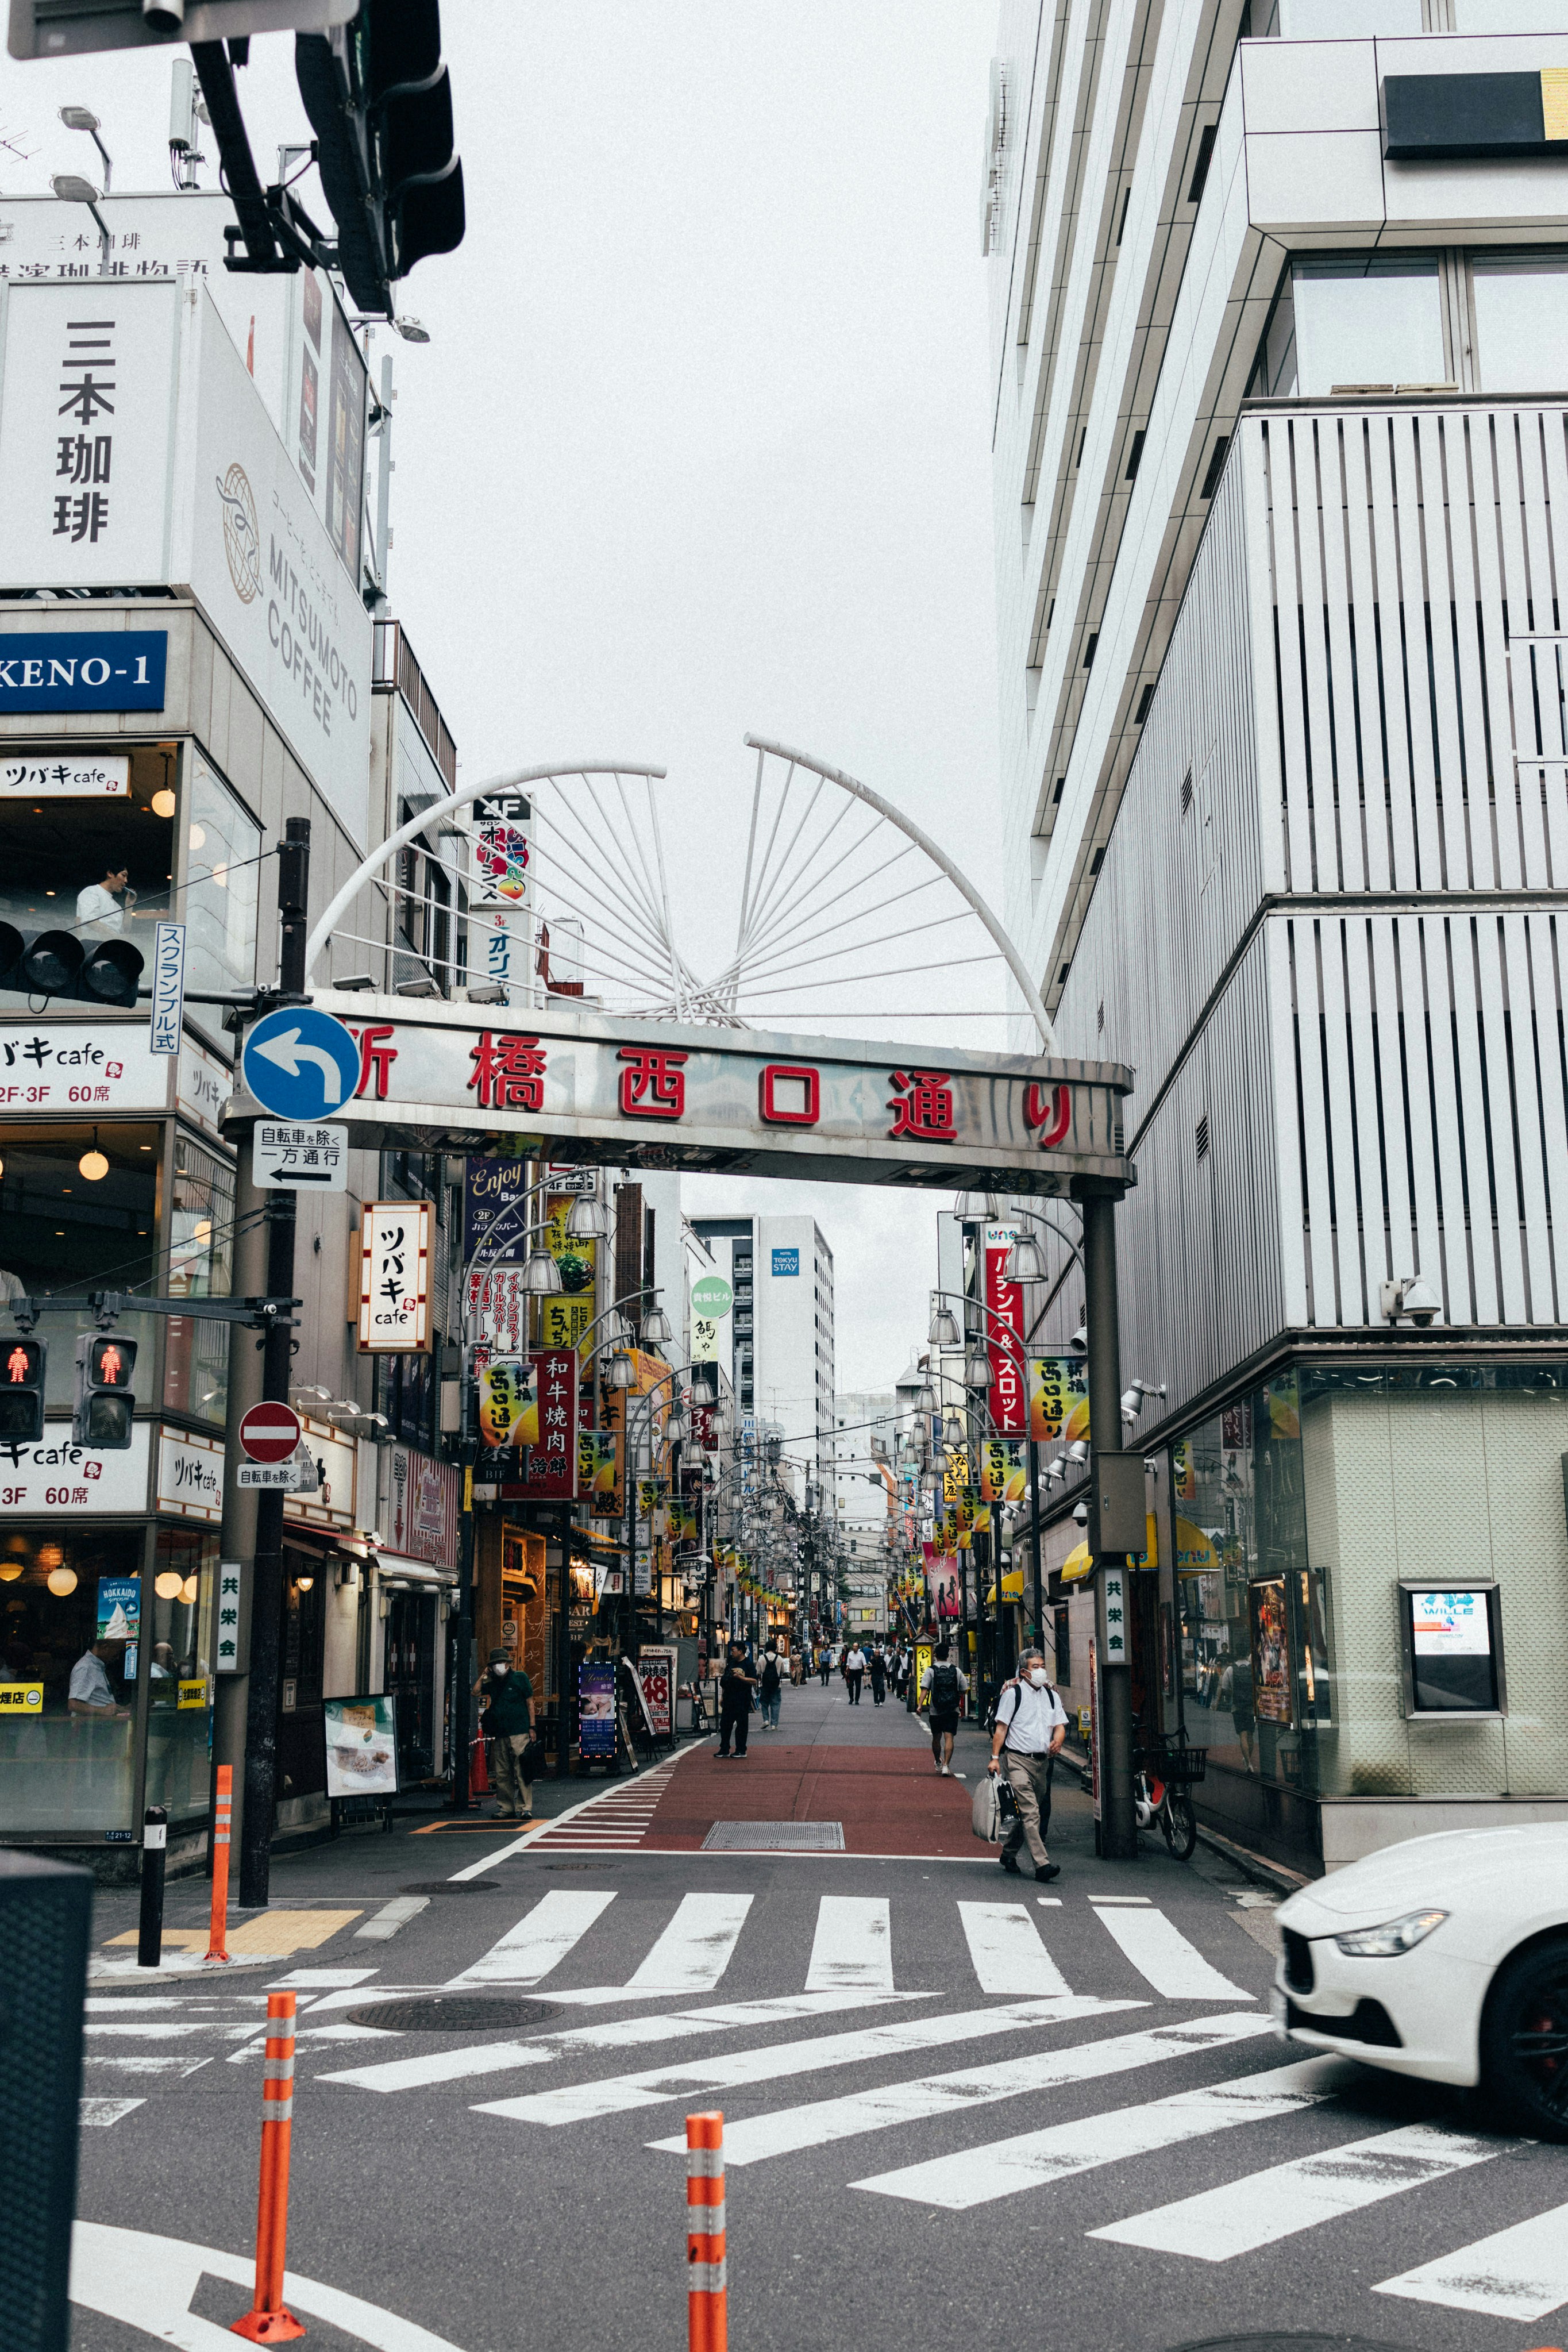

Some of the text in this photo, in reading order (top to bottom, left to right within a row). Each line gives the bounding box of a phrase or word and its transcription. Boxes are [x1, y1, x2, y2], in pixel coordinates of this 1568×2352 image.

[52, 321, 116, 543] 三本珈琲
[269, 533, 357, 721] MITSUMOTO
[268, 599, 331, 738] COFFEE
[483, 799, 521, 817] 4F
[495, 915, 507, 926] 3F
[156, 927, 180, 1050] スクランブル式
[68, 1085, 110, 1102] 60席
[261, 1128, 340, 1146] 自転車を除く
[261, 1149, 340, 1166] 一方通行
[470, 1164, 522, 1198] Enjoy
[549, 1182, 563, 1190] 4F
[472, 1222, 518, 1231] カラケバー
[477, 1210, 491, 1220] 2F
[380, 1226, 405, 1305] ツバキ
[773, 1264, 798, 1272] STAY
[375, 1308, 409, 1326] cafe
[494, 1273, 506, 1333] ガールズバー
[507, 1273, 519, 1353] イメージコスプ
[579, 1306, 588, 1335] ヒロシ
[514, 1370, 533, 1402] 新橋
[1067, 1361, 1087, 1394] 新橋
[490, 1370, 511, 1444] 西口通り
[545, 1356, 569, 1453] 和牛焼肉
[1041, 1361, 1063, 1438] 西口通り
[693, 1408, 704, 1443] ラーメ
[579, 1435, 595, 1490] 西口通り
[989, 1443, 1005, 1499] 西口通り
[1008, 1443, 1022, 1468] 新橋
[241, 1470, 296, 1484] 自転車を除く
[2, 1487, 89, 1505] 3F 60席
[103, 1588, 136, 1599] HOKKAIDO
[219, 1577, 238, 1657] 共栄会
[1107, 1581, 1123, 1650] 共栄会
[639, 1665, 668, 1679] 串焼き
